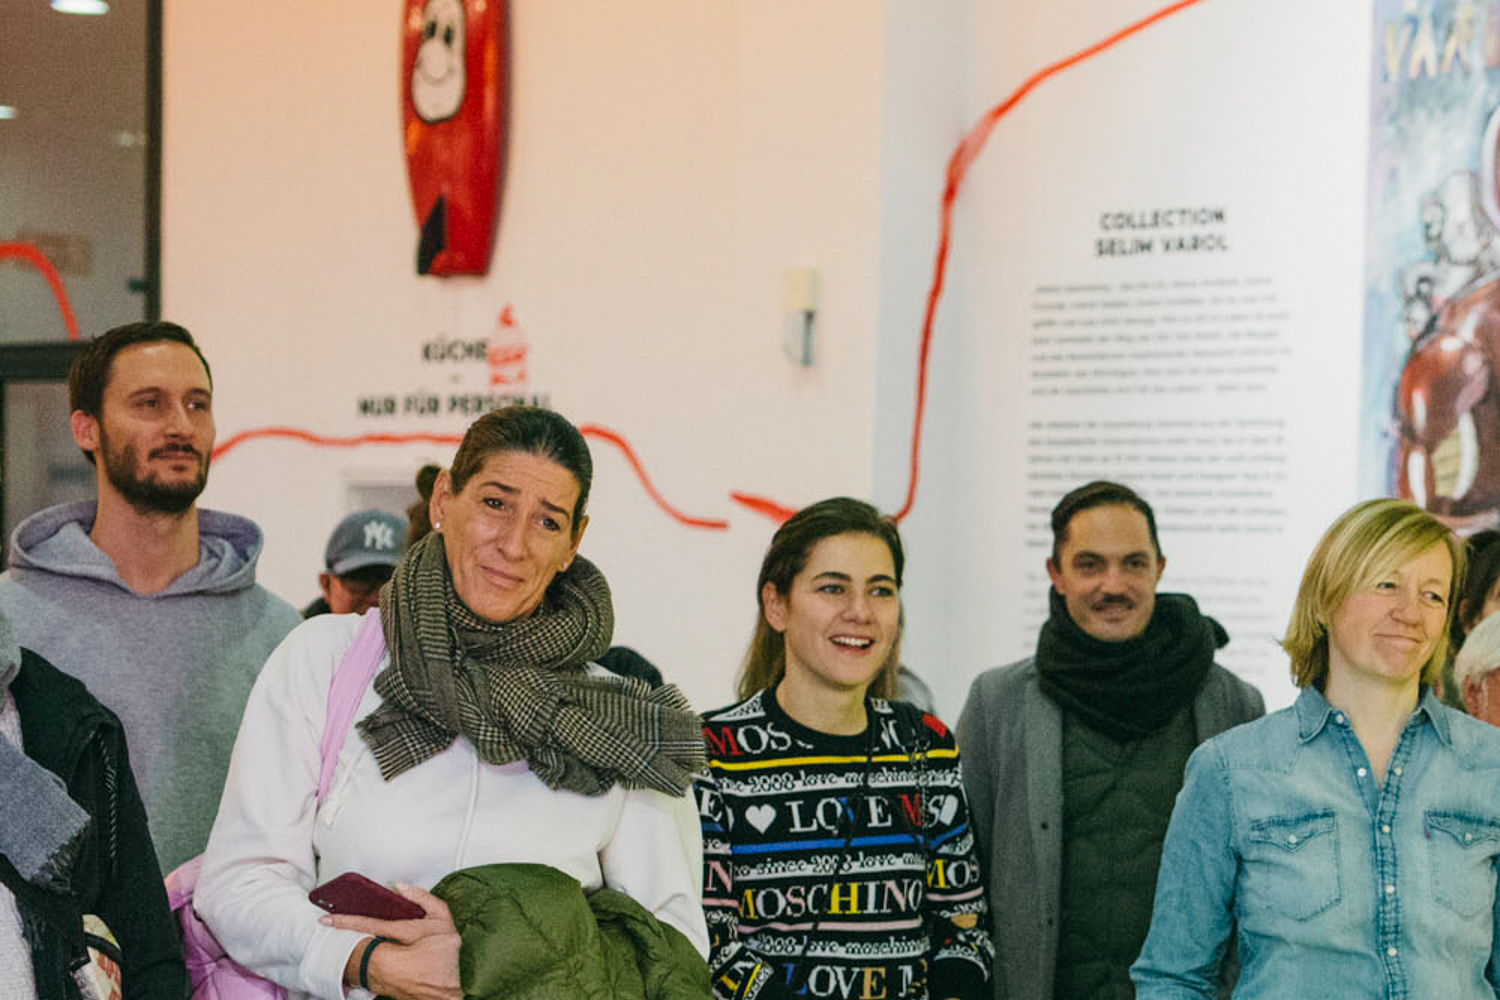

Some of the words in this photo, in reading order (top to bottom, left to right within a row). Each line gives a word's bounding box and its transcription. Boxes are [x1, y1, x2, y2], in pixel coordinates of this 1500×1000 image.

[1101, 207, 1224, 231] COLLECTION
[1097, 236, 1152, 257] SELIM
[1162, 234, 1228, 253] VAROL
[422, 334, 487, 362] KÜCHE
[358, 396, 397, 416] NUR
[403, 388, 439, 415] FÜR
[364, 520, 394, 551] NY
[782, 962, 887, 1000] LOVE
